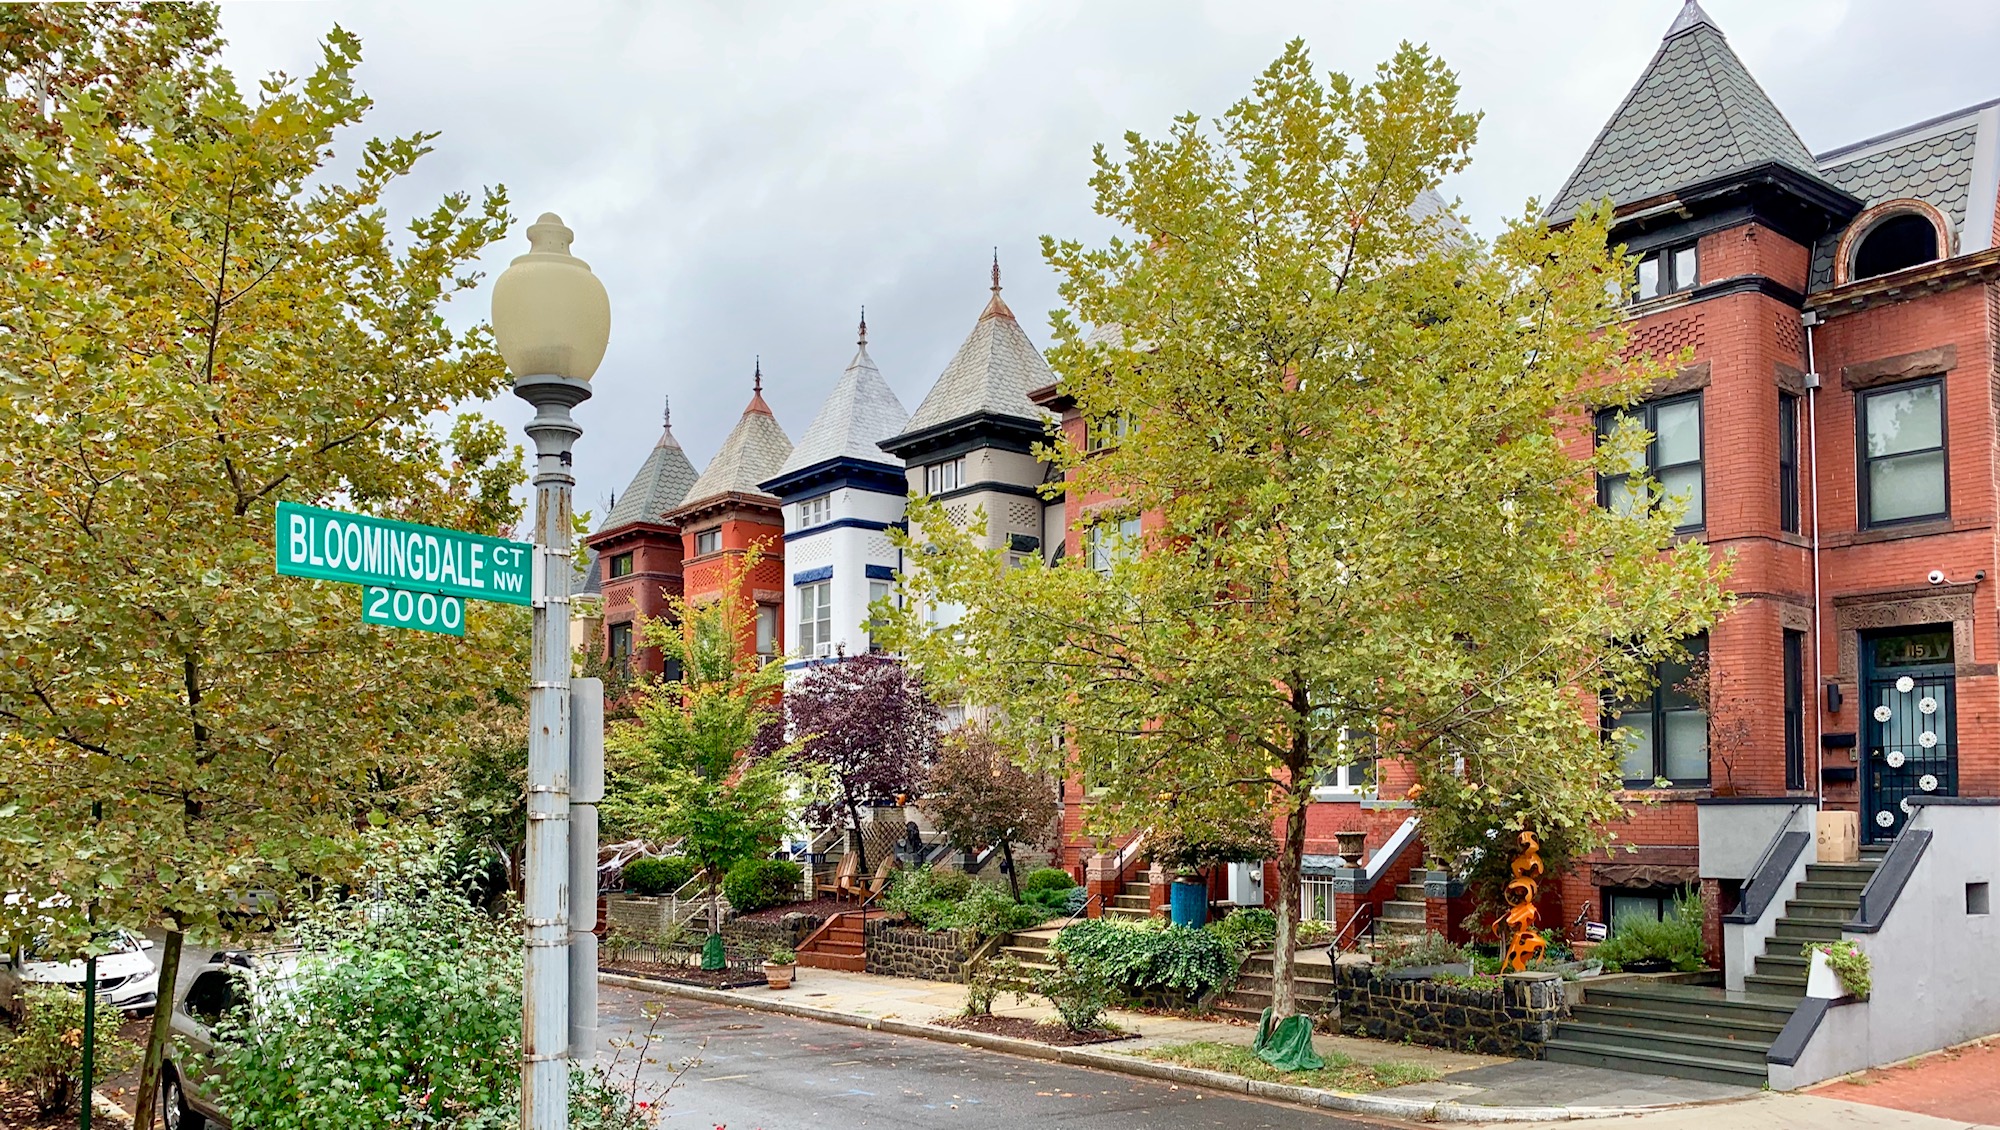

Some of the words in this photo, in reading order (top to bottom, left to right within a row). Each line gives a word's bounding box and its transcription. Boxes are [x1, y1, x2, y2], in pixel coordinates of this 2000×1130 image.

[290, 514, 484, 588] BLOOMINGDALE
[493, 547, 524, 567] CT
[494, 571, 523, 592] NW
[369, 587, 461, 628] 2000
[1905, 644, 1923, 656] 115
